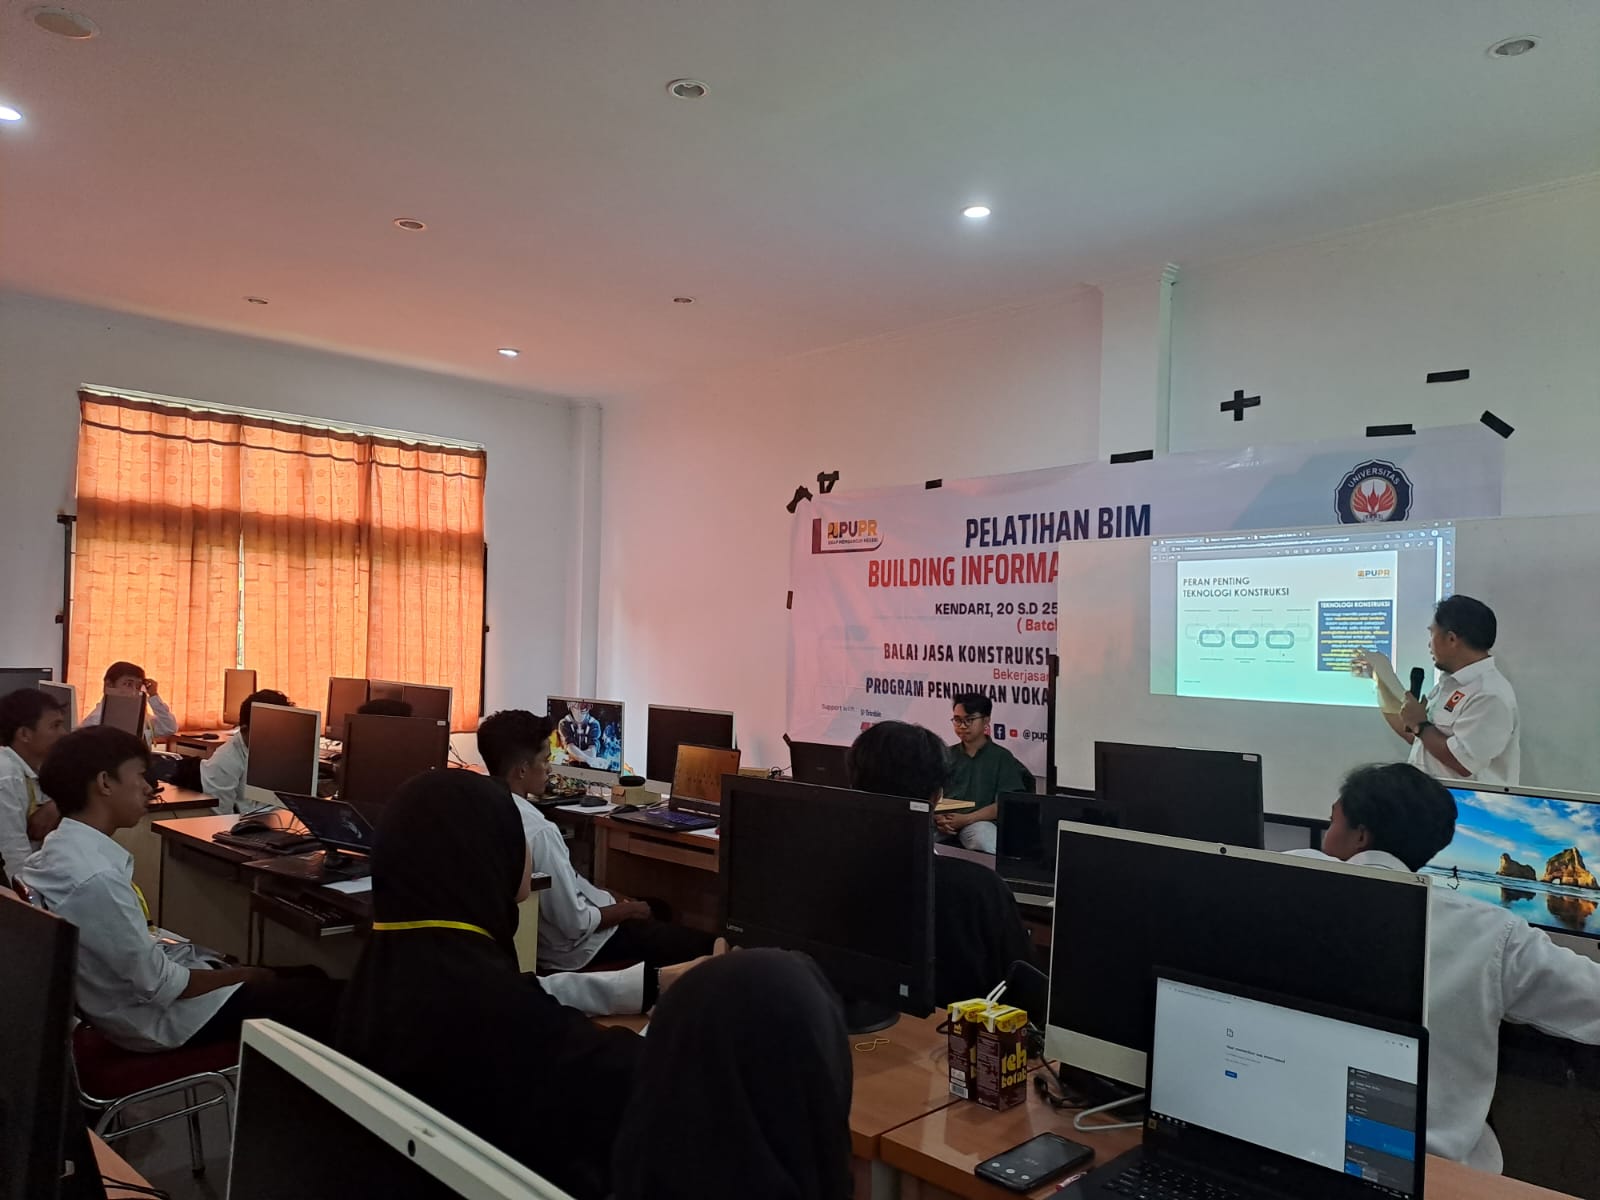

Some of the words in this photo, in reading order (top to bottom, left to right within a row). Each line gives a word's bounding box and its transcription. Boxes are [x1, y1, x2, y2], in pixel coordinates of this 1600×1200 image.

[1347, 467, 1401, 488] UNIVERSITAS
[839, 520, 877, 538] PUPR
[965, 508, 1089, 548] PELATIHAN
[1098, 504, 1151, 540] BIM
[868, 556, 955, 588] BUILDING
[1183, 578, 1211, 587] PERAN
[1212, 576, 1250, 586] PENTING
[1183, 589, 1232, 598] TEKNOLOGI
[1234, 587, 1290, 597] KONSTRUKSI
[935, 602, 994, 618] KENDARI,
[996, 602, 1014, 615] 20
[1017, 602, 1039, 615] S.D
[1042, 602, 1058, 615] 25
[883, 643, 918, 661] BALAI
[922, 644, 954, 662] JASA
[958, 645, 1050, 666] KONSTRUKSI
[993, 668, 1049, 684] Bekerjasa
[866, 677, 924, 698] PROGRAM
[928, 681, 1007, 704] PENDIDIKAN
[1011, 686, 1049, 706] VOKA
[1001, 1042, 1027, 1074] teh
